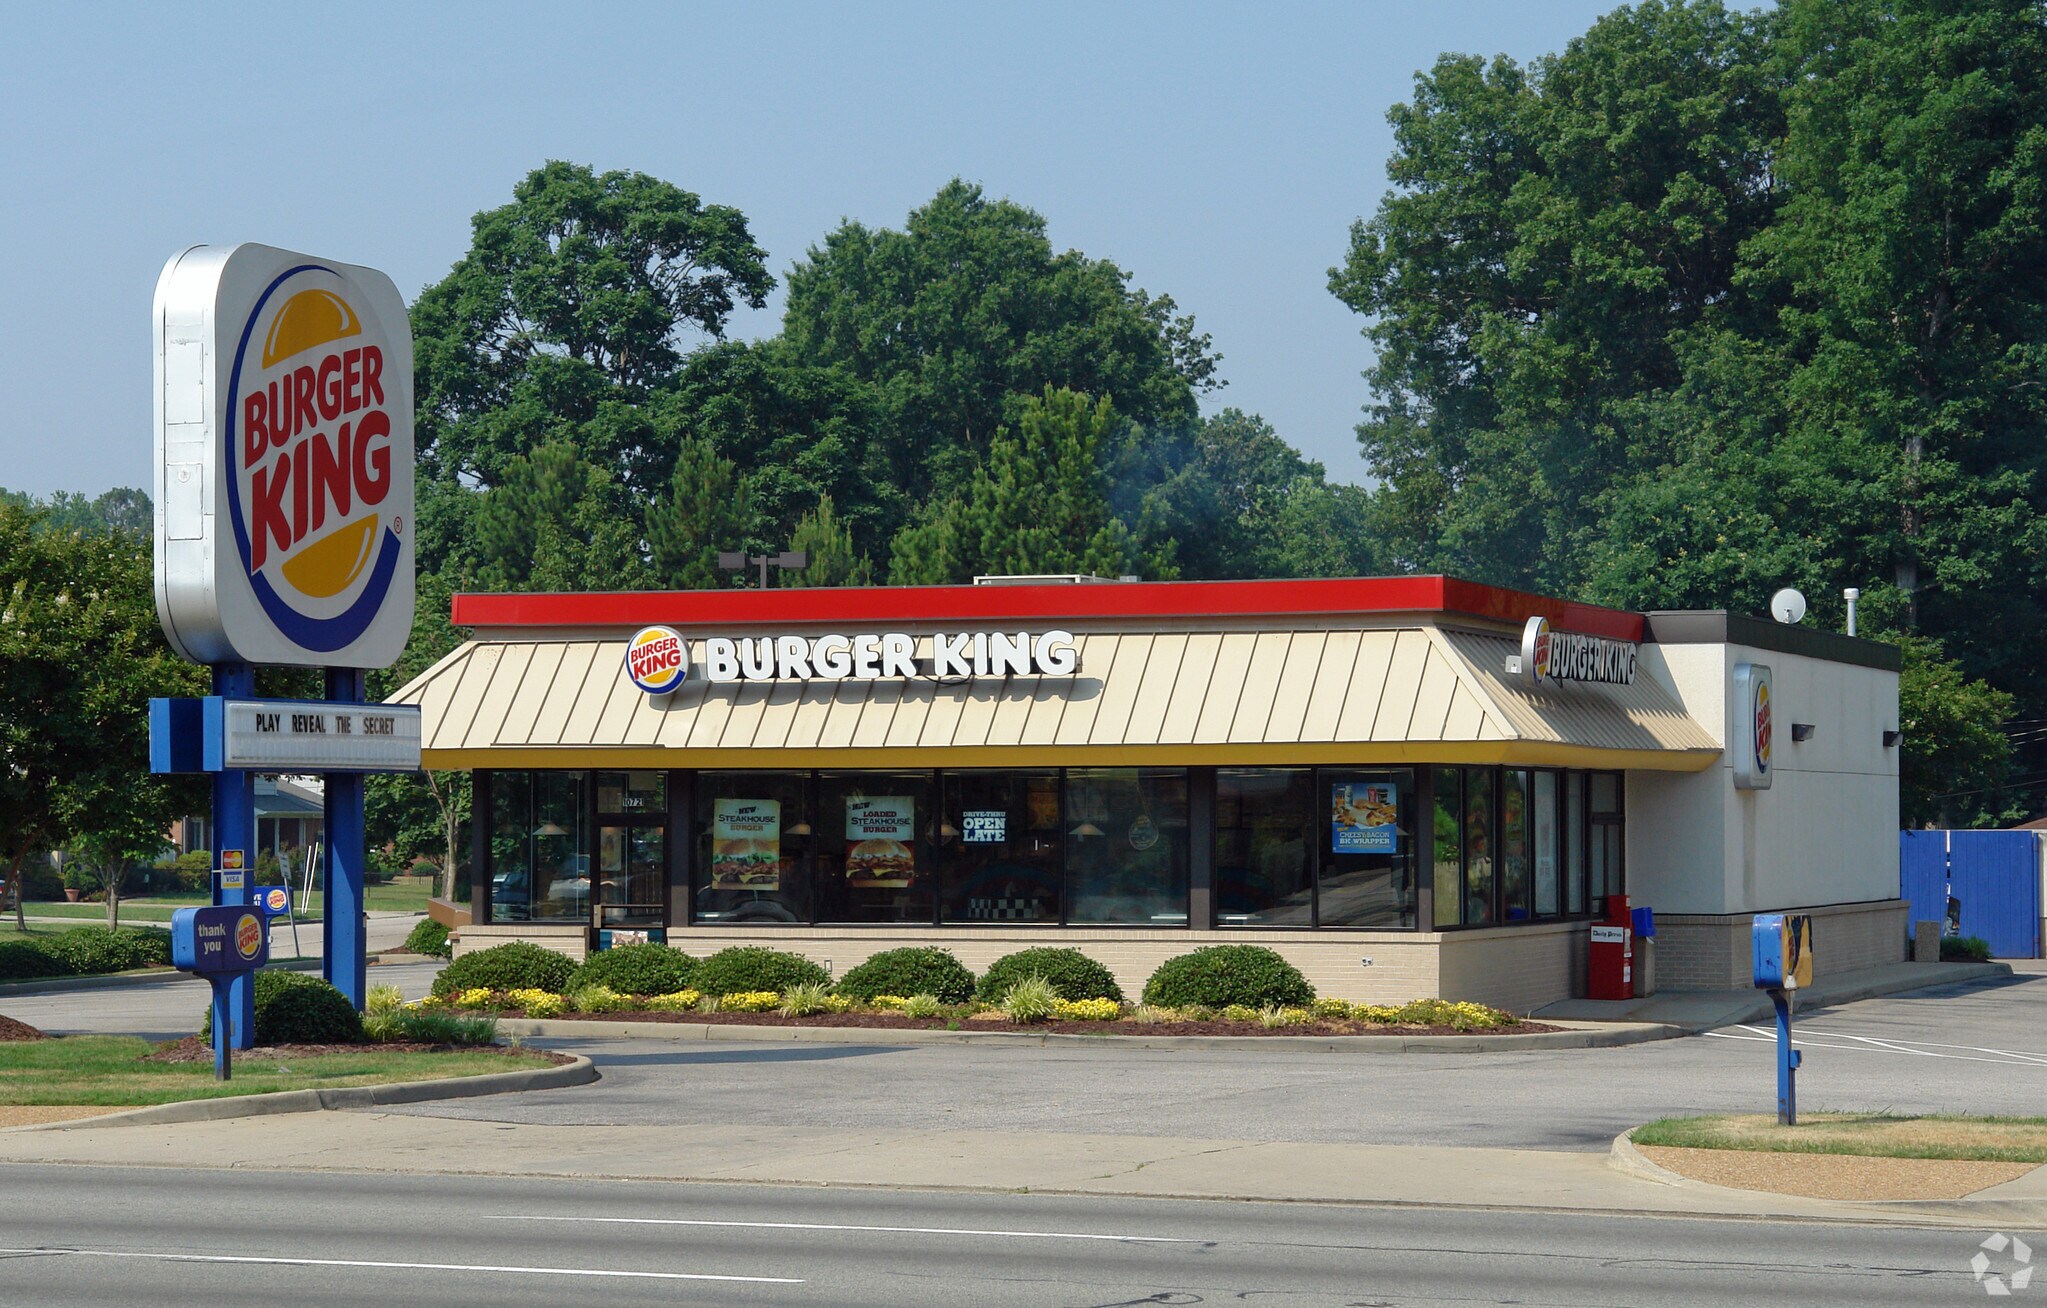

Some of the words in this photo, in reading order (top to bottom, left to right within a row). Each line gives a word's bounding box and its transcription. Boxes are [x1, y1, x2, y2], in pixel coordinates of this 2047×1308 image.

[244, 345, 384, 469] BURGER
[251, 410, 391, 572] KING
[631, 637, 678, 663] BURGER
[705, 633, 918, 682] BURGER
[933, 629, 1077, 677] KING
[633, 649, 681, 680] KING
[1550, 632, 1601, 681] BURGER
[1602, 639, 1637, 685] KING
[256, 713, 281, 732] PLAY
[292, 714, 326, 734] REVEAL
[335, 715, 351, 734] THE
[363, 717, 395, 735] SECRET
[738, 806, 757, 814] NEW
[852, 802, 870, 810] NEW
[718, 814, 775, 823] STEAKHOUSE
[851, 817, 911, 825] STEAKHOUSE
[963, 817, 1006, 829] OPEN
[730, 824, 764, 832] BURGER
[963, 829, 1005, 842] LATE
[225, 875, 240, 883] VISA
[198, 923, 226, 938] thank
[238, 922, 258, 940] BURGER
[203, 941, 222, 955] you
[239, 930, 259, 951] KING
